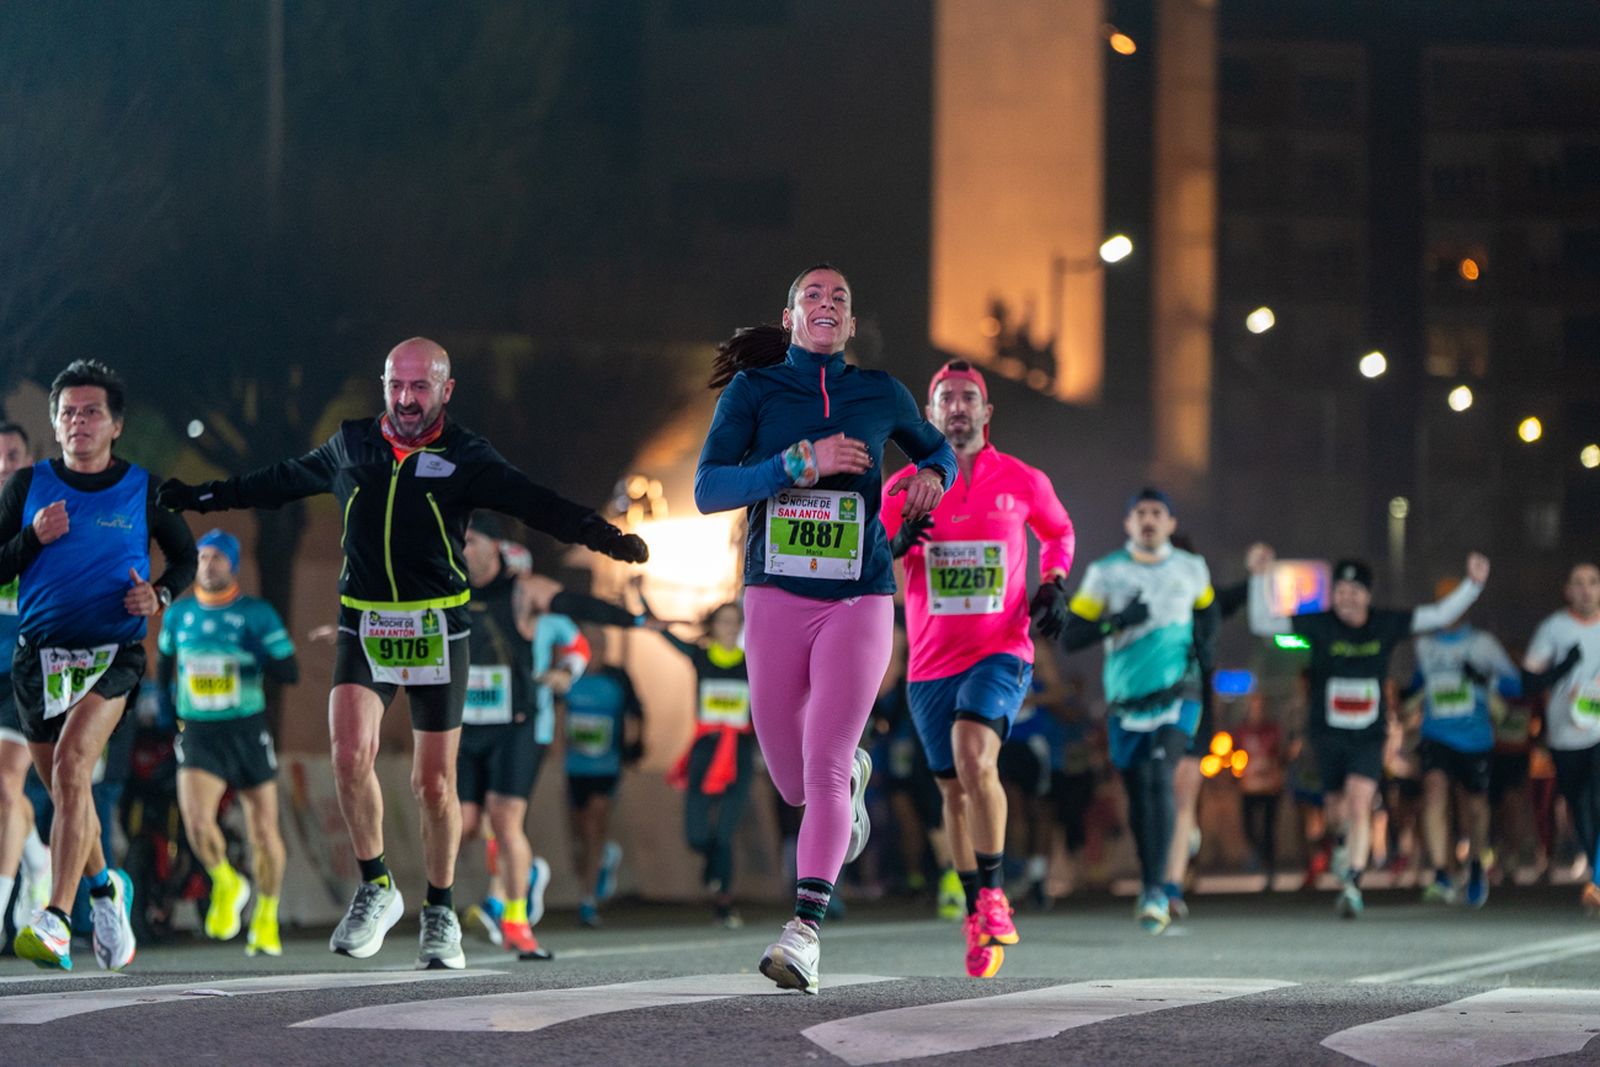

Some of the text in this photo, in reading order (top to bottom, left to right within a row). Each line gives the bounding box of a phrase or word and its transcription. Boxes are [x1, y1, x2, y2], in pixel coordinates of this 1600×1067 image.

[789, 497, 818, 507] NOCHE
[820, 500, 831, 509] DE
[778, 508, 797, 517] SAN
[788, 520, 845, 548] 7887
[938, 567, 996, 589] 12267
[379, 620, 414, 628] NOCHE DE
[380, 638, 429, 660] 9176
